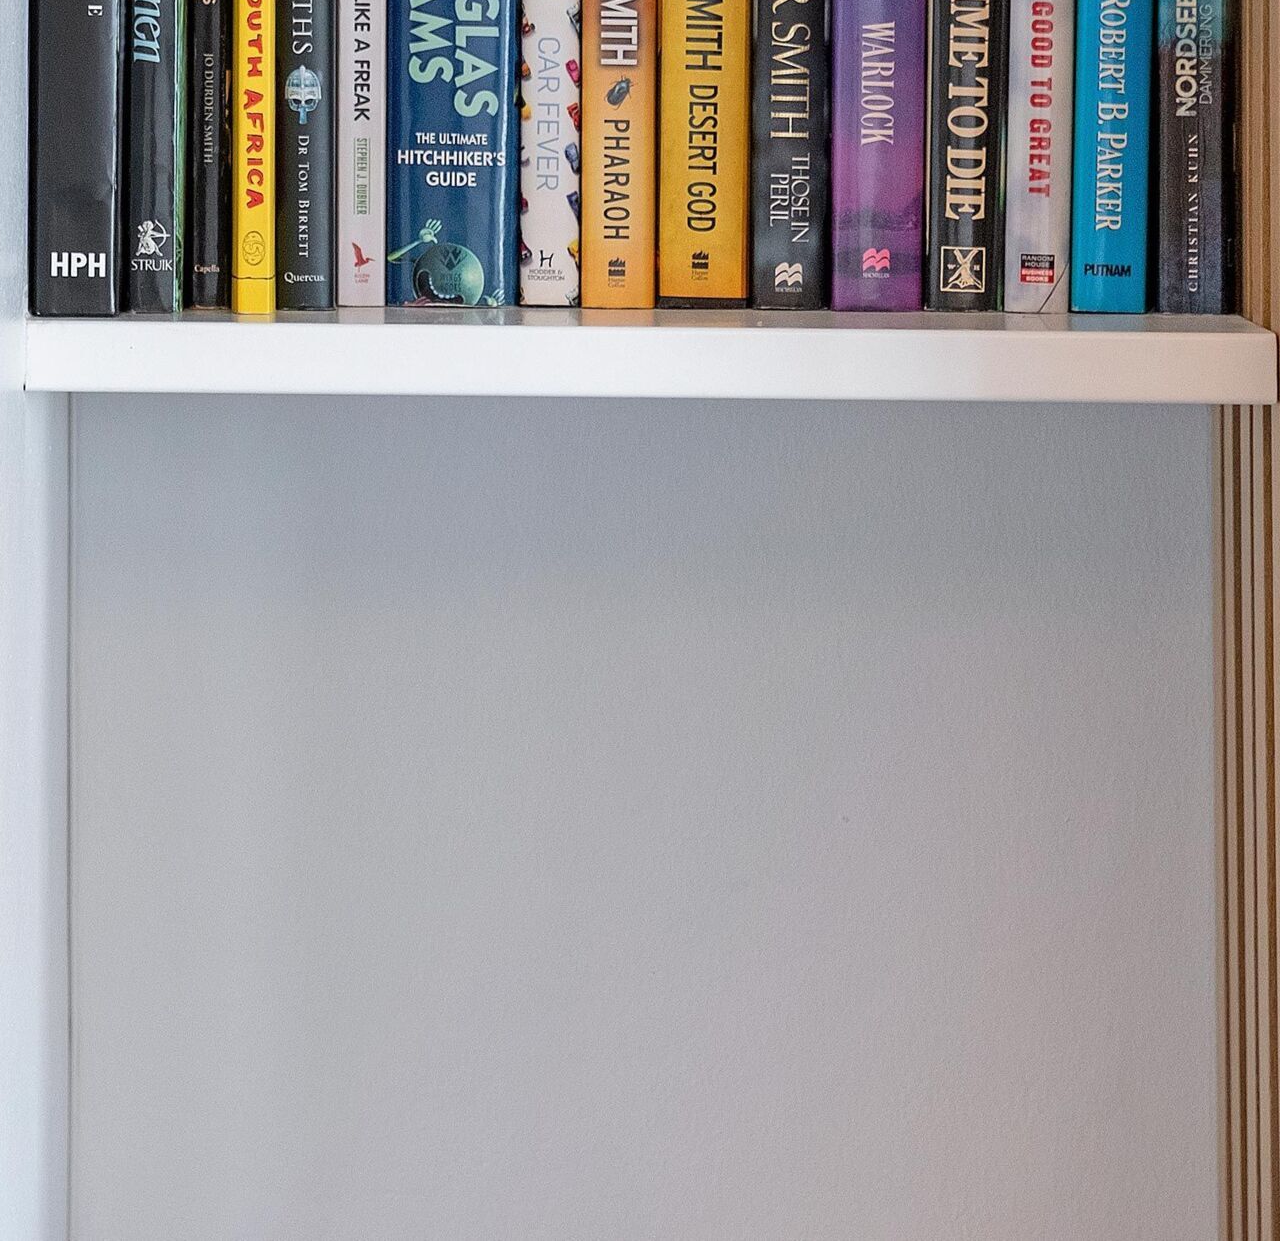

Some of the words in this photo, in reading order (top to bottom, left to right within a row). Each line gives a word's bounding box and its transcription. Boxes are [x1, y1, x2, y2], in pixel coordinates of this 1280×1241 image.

[203, 53, 214, 68] JO
[354, 37, 371, 54] A
[1029, 1, 1055, 69] GOOD
[354, 59, 371, 122] FREAK
[536, 37, 561, 93] CAR
[770, 21, 811, 140] SMITH
[859, 20, 896, 146] WARLOCK
[203, 70, 214, 122] DURDEN
[946, 76, 989, 139] TO
[1029, 77, 1053, 108] TO
[1097, 100, 1130, 125] B.
[203, 125, 214, 164] SMITH
[243, 88, 265, 210] AFRICA
[297, 134, 310, 156] DR
[415, 132, 436, 146] THE
[438, 132, 488, 146] ULTIMATE
[536, 102, 560, 192] FEVER
[687, 84, 718, 176] DESERT
[297, 160, 310, 193] TOM
[397, 149, 507, 168] HITCHHIKER'S
[425, 171, 478, 188] GUIDE
[603, 119, 630, 240] PHARAOH
[944, 145, 987, 221] DIE
[1028, 118, 1052, 198] GREAT
[1094, 132, 1129, 232] PARKER
[1188, 134, 1199, 184] KUHN
[686, 181, 717, 233] GOD
[770, 173, 790, 227] PERIL
[790, 153, 811, 218] THOSE
[297, 199, 310, 259] BIRKETT
[790, 222, 810, 243] IN
[1188, 191, 1199, 293] CHRISTIAN
[50, 252, 106, 278] HPH
[130, 258, 173, 271] STRUIK
[194, 263, 220, 274] Capella
[527, 274, 566, 282] STOUGHTON
[1083, 264, 1132, 278] PUTNAM
